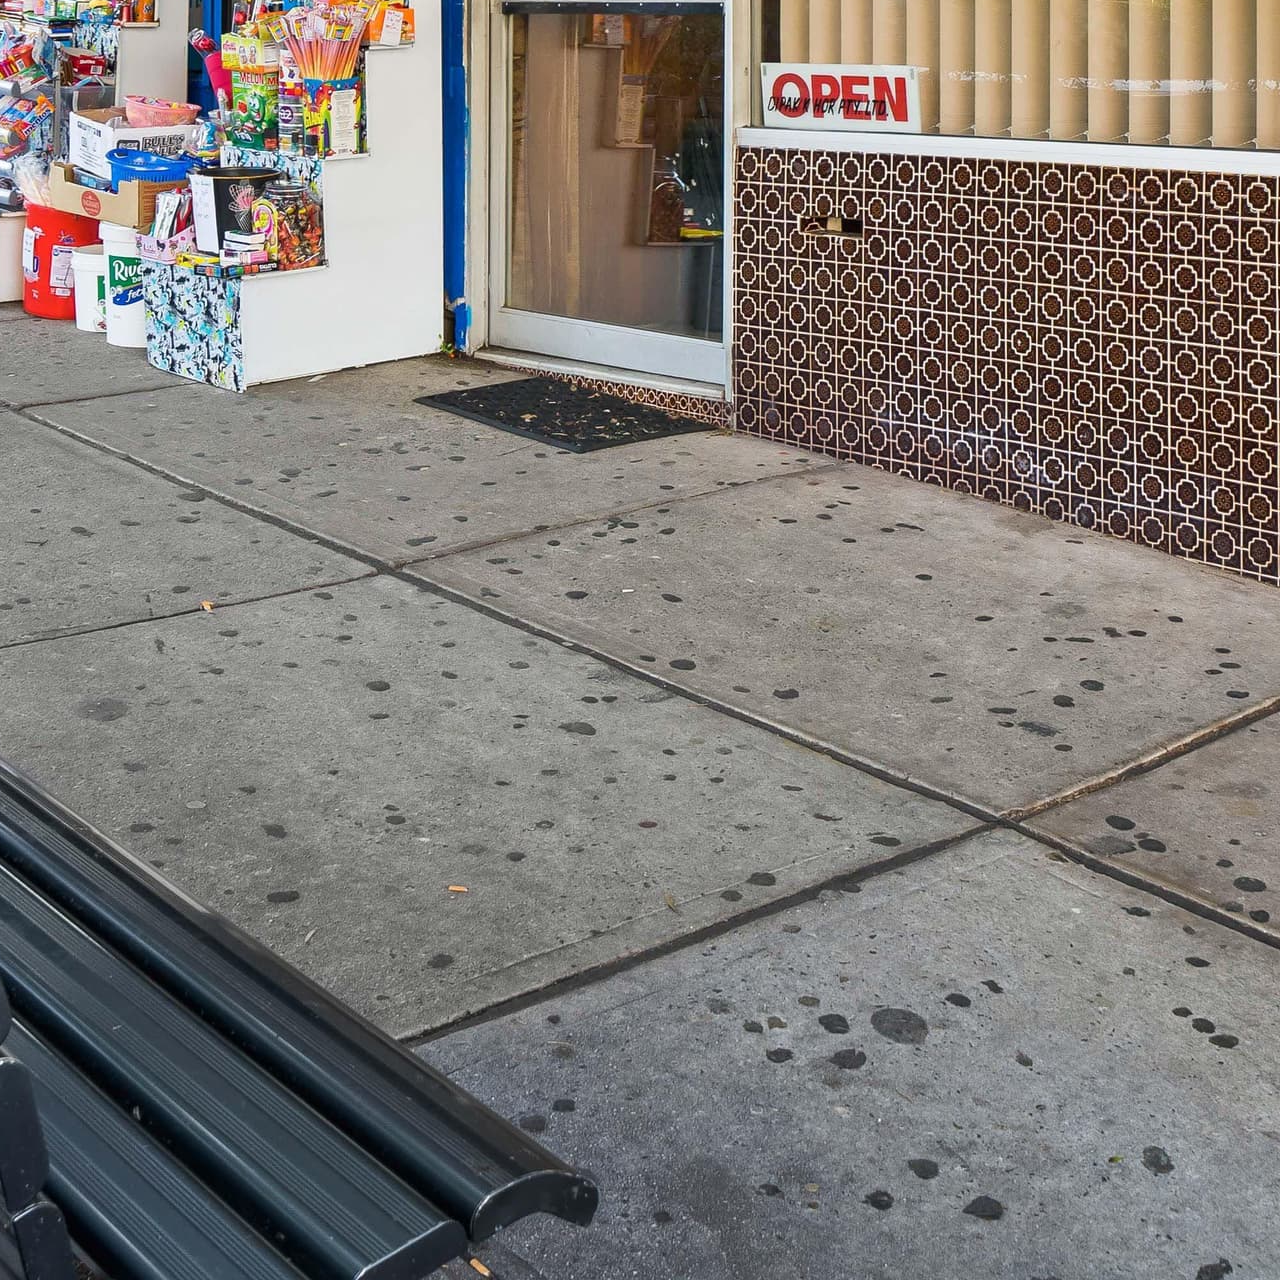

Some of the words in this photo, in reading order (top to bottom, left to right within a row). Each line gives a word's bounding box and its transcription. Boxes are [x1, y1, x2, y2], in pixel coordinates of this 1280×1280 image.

[240, 72, 264, 85] MELON
[772, 73, 909, 122] OPEN
[814, 98, 836, 115] HOR
[24, 108, 51, 136] mentos
